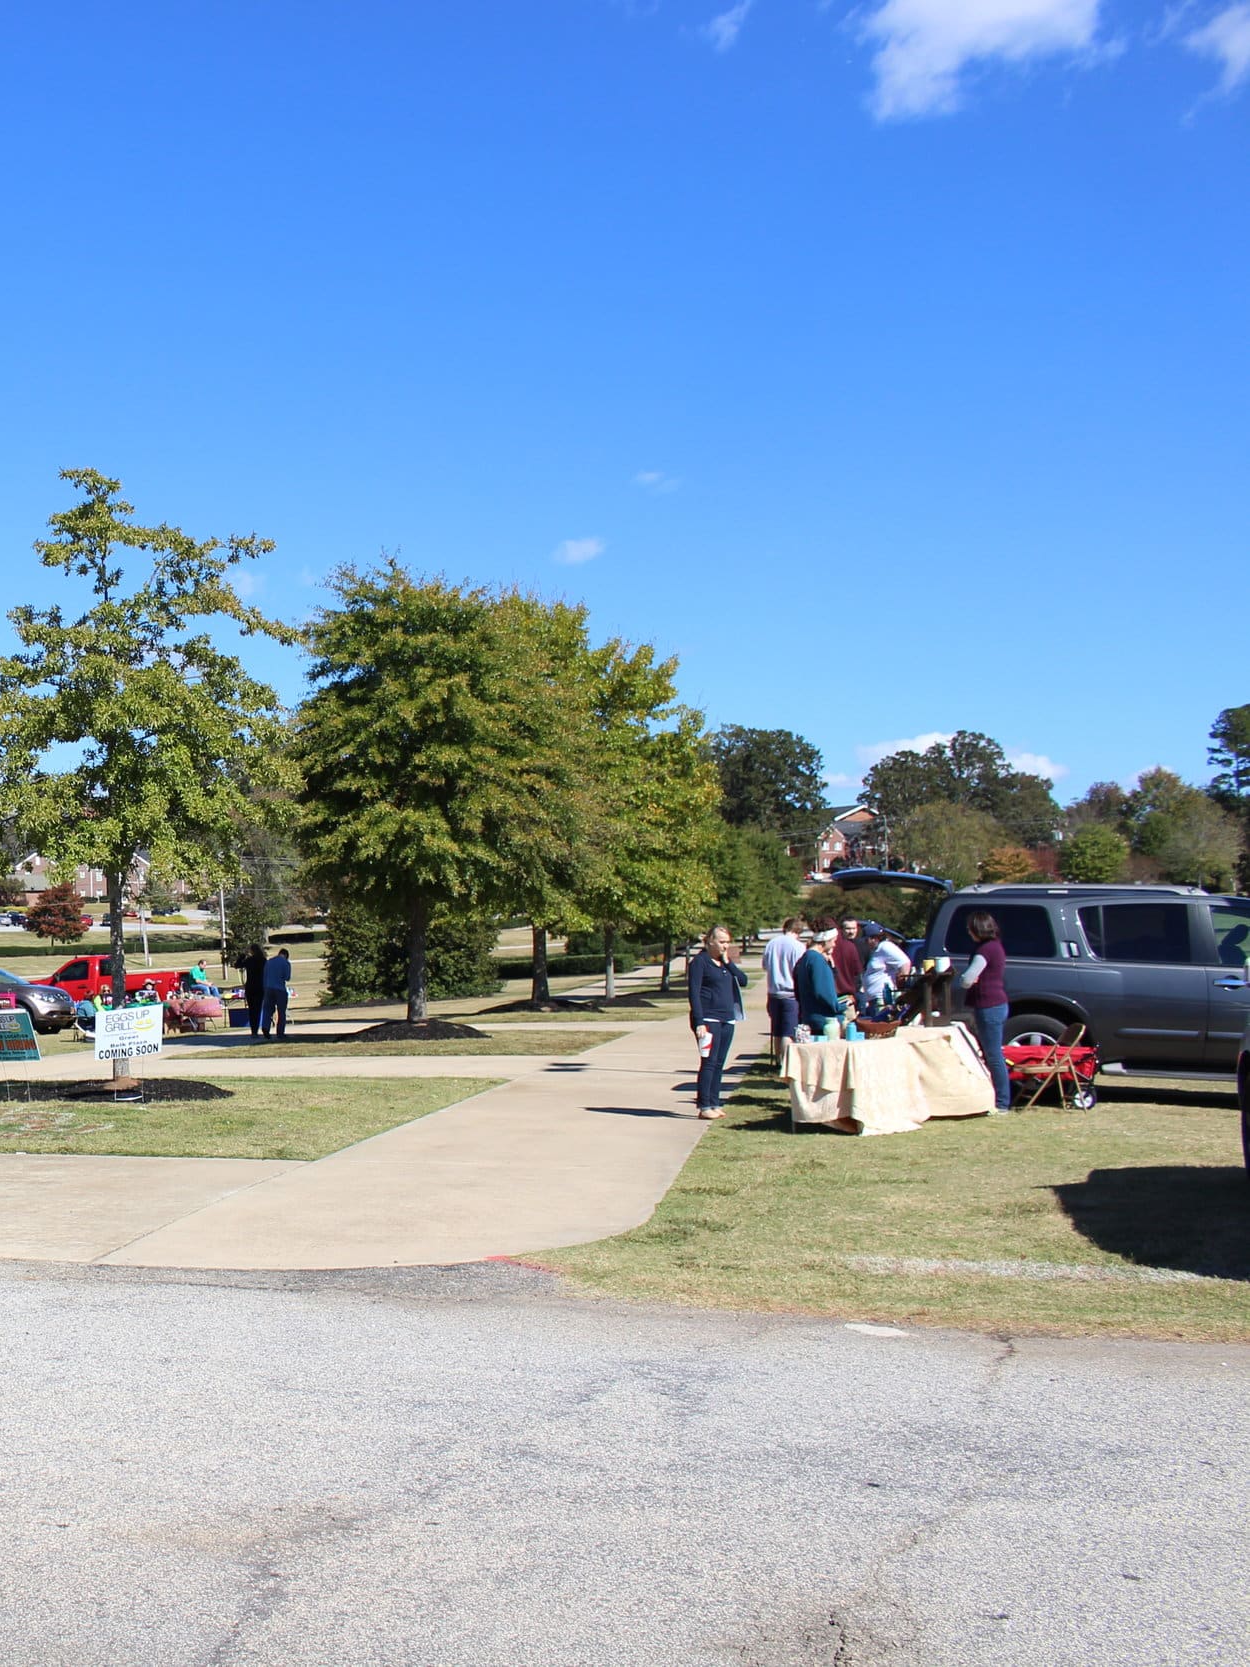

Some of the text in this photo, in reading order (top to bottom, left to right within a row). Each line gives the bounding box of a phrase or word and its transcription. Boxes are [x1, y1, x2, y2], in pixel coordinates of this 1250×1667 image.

[105, 1009, 150, 1024] EGGS UP
[105, 1022, 134, 1033] GRILL
[6, 1039, 37, 1050] HIRING
[98, 1043, 159, 1060] COMING SOON
